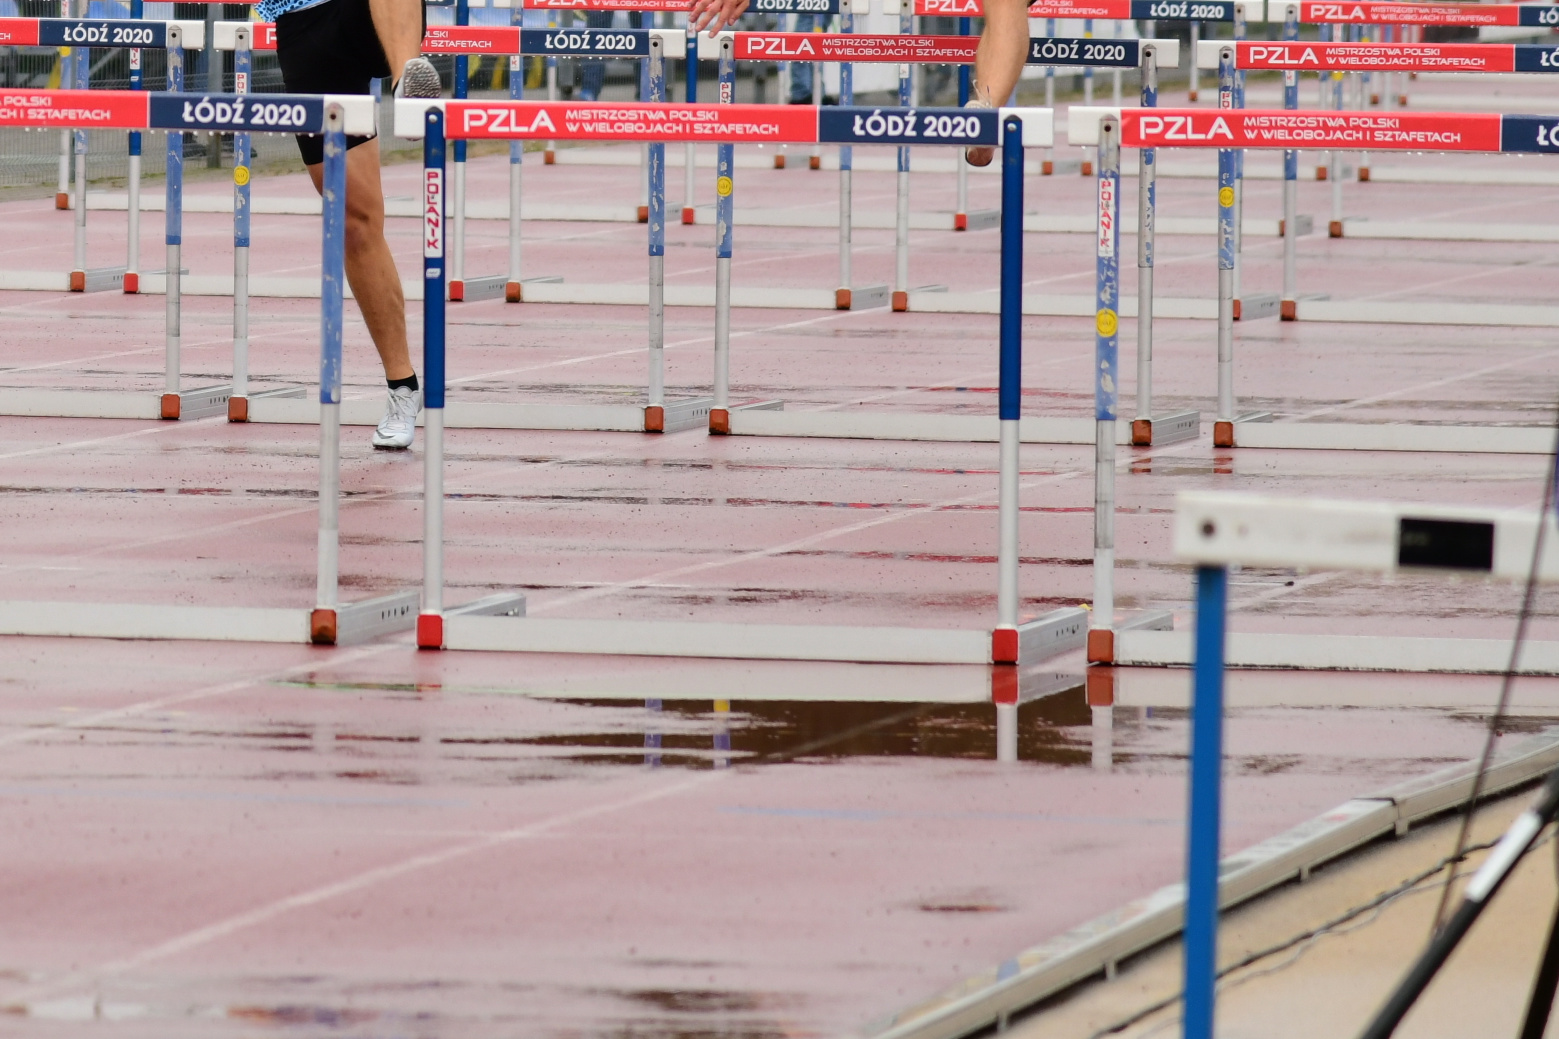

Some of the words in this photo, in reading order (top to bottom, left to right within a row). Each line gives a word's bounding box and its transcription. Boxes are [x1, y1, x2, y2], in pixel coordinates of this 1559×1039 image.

[664, 0, 691, 9] SZTAF
[1150, 0, 1189, 17] ŁÓDŹ
[1190, 5, 1224, 18] 2020
[1311, 5, 1366, 19] PZLA
[1539, 7, 1559, 24] ŁÓ
[63, 23, 108, 42] ŁÓDŹ
[113, 28, 153, 43] 2020
[423, 30, 450, 39] LSKI
[545, 30, 590, 50] ŁÓDŹ
[595, 35, 635, 49] 2020
[430, 39, 492, 48] SZTAFETACH
[748, 38, 815, 54] PZLA
[821, 38, 897, 47] MISTRZOSTWA
[898, 38, 934, 47] POLSKI
[1033, 39, 1078, 58] ŁÓDŹ
[1084, 45, 1125, 60] 2020
[822, 47, 833, 55] W
[834, 47, 909, 56] WIELOBOJACH
[915, 48, 977, 57] SZTAFETACH
[1250, 47, 1319, 64] PZLA
[1325, 47, 1402, 56] MISTRZOSTWA
[1403, 47, 1441, 56] POLSKI
[1540, 48, 1559, 66] ŁÓ
[1325, 56, 1337, 65] W
[1337, 56, 1414, 65] WIELOBOJACH
[1421, 57, 1486, 66] SZTAFETACH
[3, 95, 52, 107] POLSKI
[26, 108, 111, 121] SZTAFETACH
[182, 94, 244, 124] ŁÓDŹ
[250, 104, 306, 126] 2020
[565, 109, 668, 121] MISTRZOSTWA
[669, 110, 719, 122] POLSKI
[464, 109, 556, 132] PZLA
[565, 121, 581, 132] W
[581, 122, 684, 134] WIELOBOJACH
[693, 122, 780, 135] SZTAFETACH
[853, 110, 917, 136] ŁÓDŹ
[923, 116, 980, 137] 2020
[1140, 117, 1233, 139] PZLA
[1243, 116, 1347, 128] MISTRZOSTWA
[1349, 117, 1400, 129] POLSKI
[1243, 128, 1259, 139] W
[1260, 129, 1363, 141] WIELOBOJACH
[1373, 130, 1462, 143] SZTAFETACH
[427, 171, 440, 250] POLANIK
[1100, 180, 1112, 248] POLANIK
